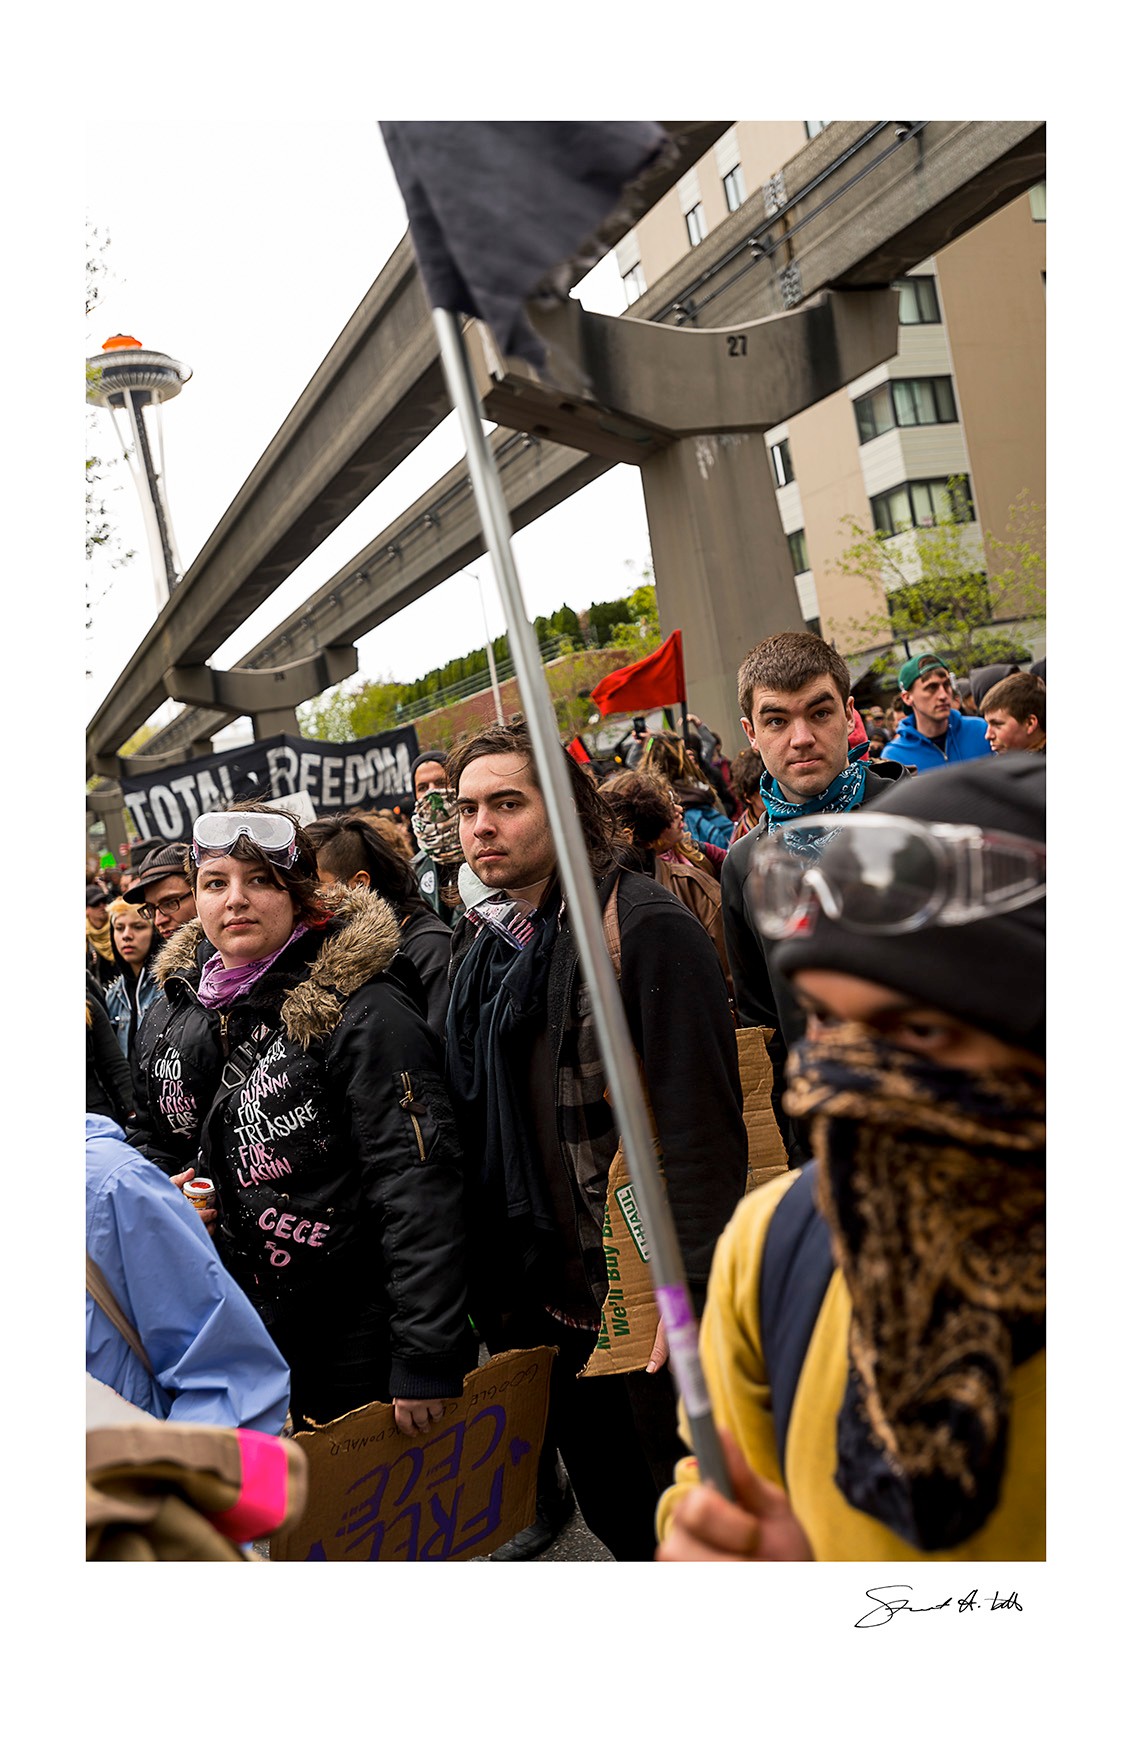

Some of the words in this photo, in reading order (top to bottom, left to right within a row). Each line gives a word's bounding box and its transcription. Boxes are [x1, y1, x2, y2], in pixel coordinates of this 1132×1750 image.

[727, 335, 747, 357] 27
[247, 743, 412, 806] REEDOM
[154, 1058, 182, 1081] COKO
[162, 1079, 184, 1098] FOR
[166, 1111, 198, 1129] FOR
[233, 1098, 319, 1146] TREASURE
[237, 1101, 269, 1127] FOR
[238, 1143, 272, 1169] FOR
[257, 1206, 330, 1248] CECE
[620, 1189, 651, 1258] -HAUL
[603, 1244, 621, 1282] Buy
[608, 1288, 631, 1338] We'll
[335, 1403, 508, 1539] CECE
